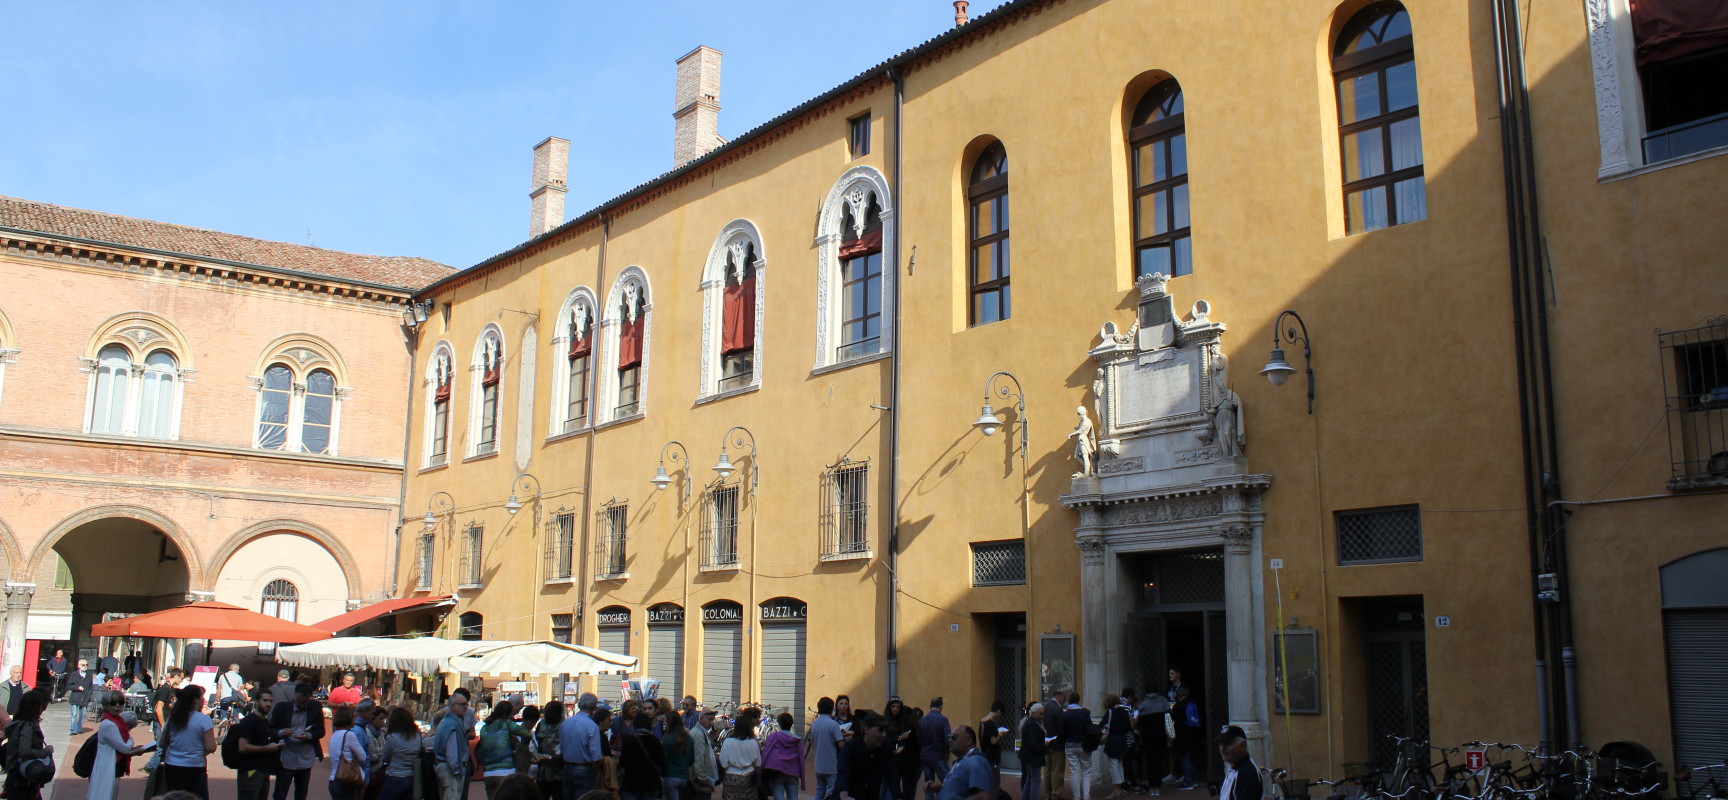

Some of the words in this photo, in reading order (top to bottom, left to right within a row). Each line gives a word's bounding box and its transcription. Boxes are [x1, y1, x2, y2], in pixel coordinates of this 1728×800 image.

[650, 610, 672, 621] BAZZI
[704, 607, 742, 619] COLONIAL
[763, 606, 791, 618] BAZZI
[1437, 617, 1448, 626] 12
